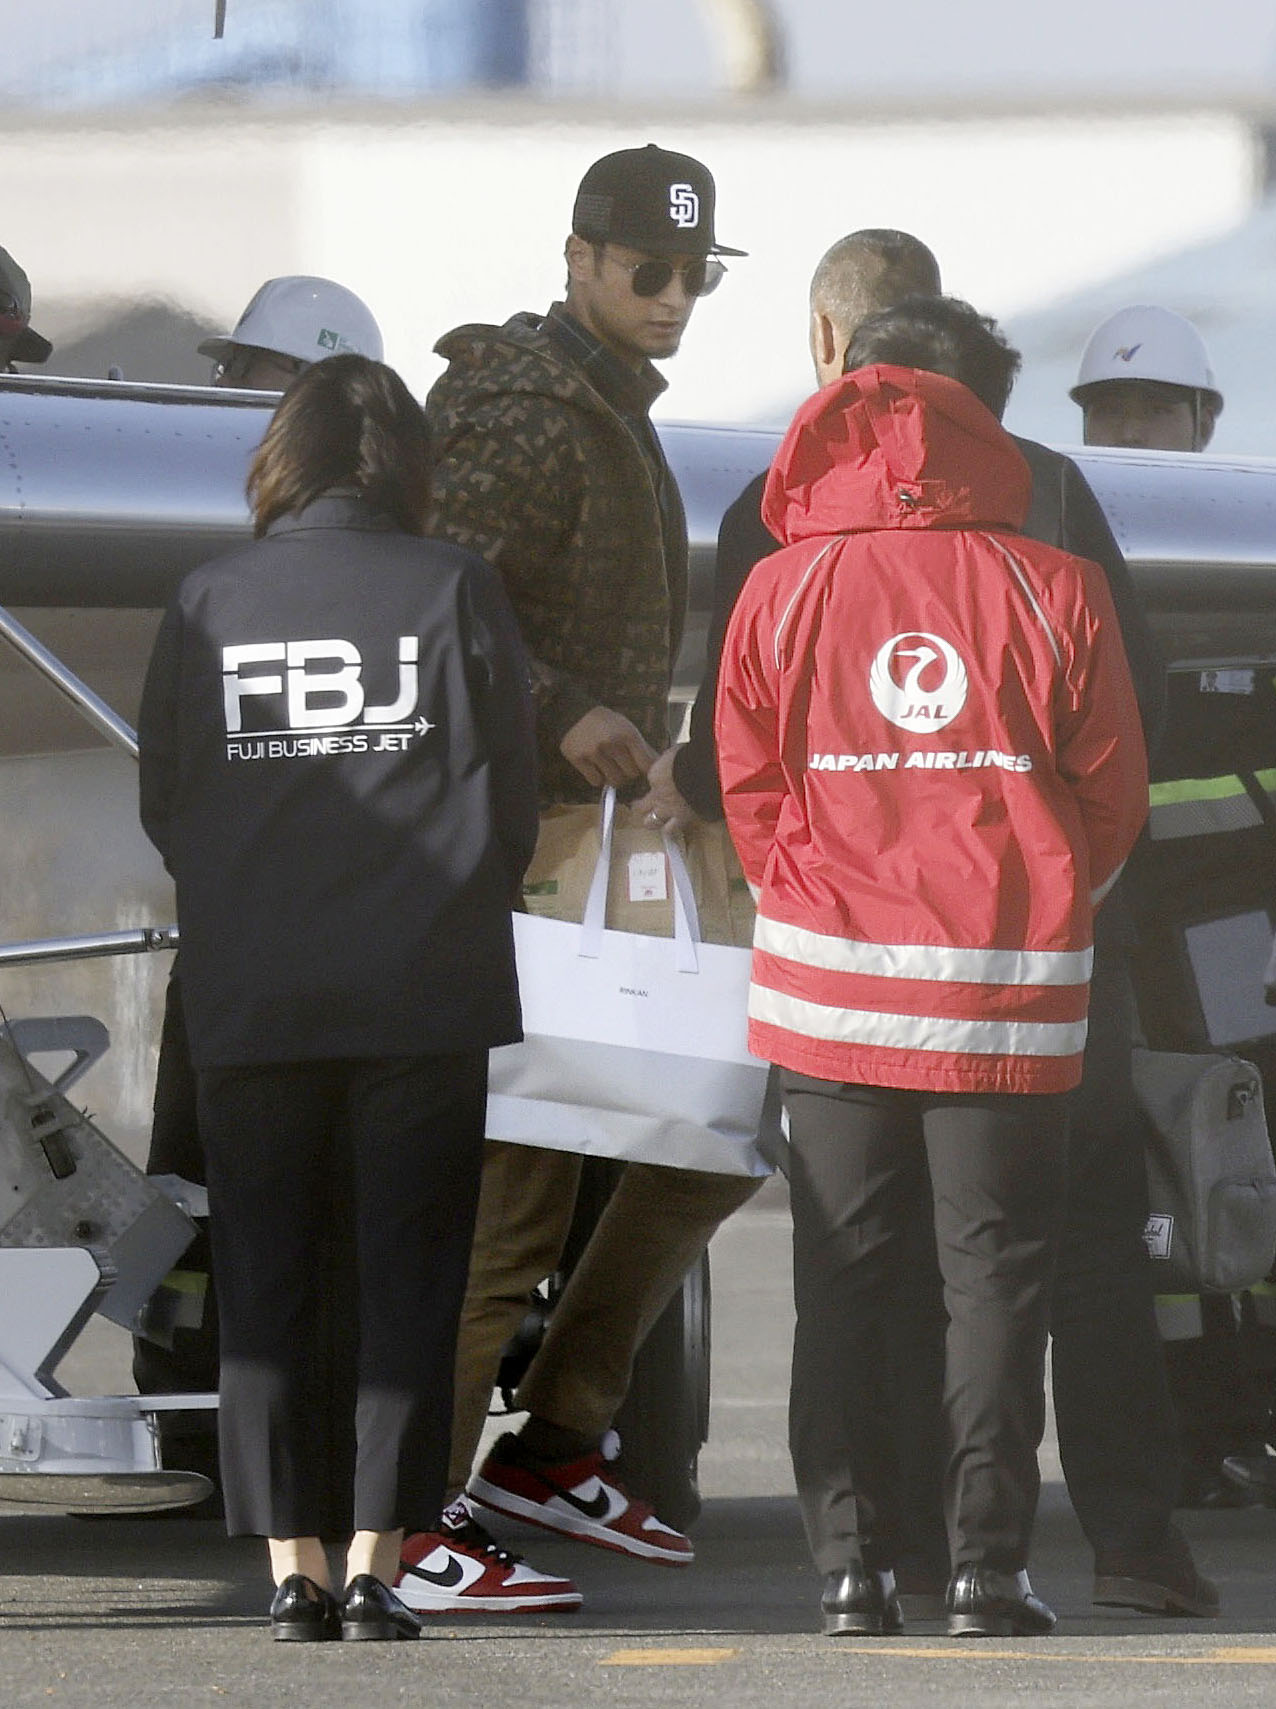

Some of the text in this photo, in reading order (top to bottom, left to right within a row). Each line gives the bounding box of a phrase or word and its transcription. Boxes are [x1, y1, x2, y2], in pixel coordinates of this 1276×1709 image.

[222, 636, 419, 732] FBJ
[900, 704, 949, 719] JAL
[226, 733, 413, 761] FUJI BUSINESS JET
[809, 749, 1033, 772] JAPAN AIRLINES
